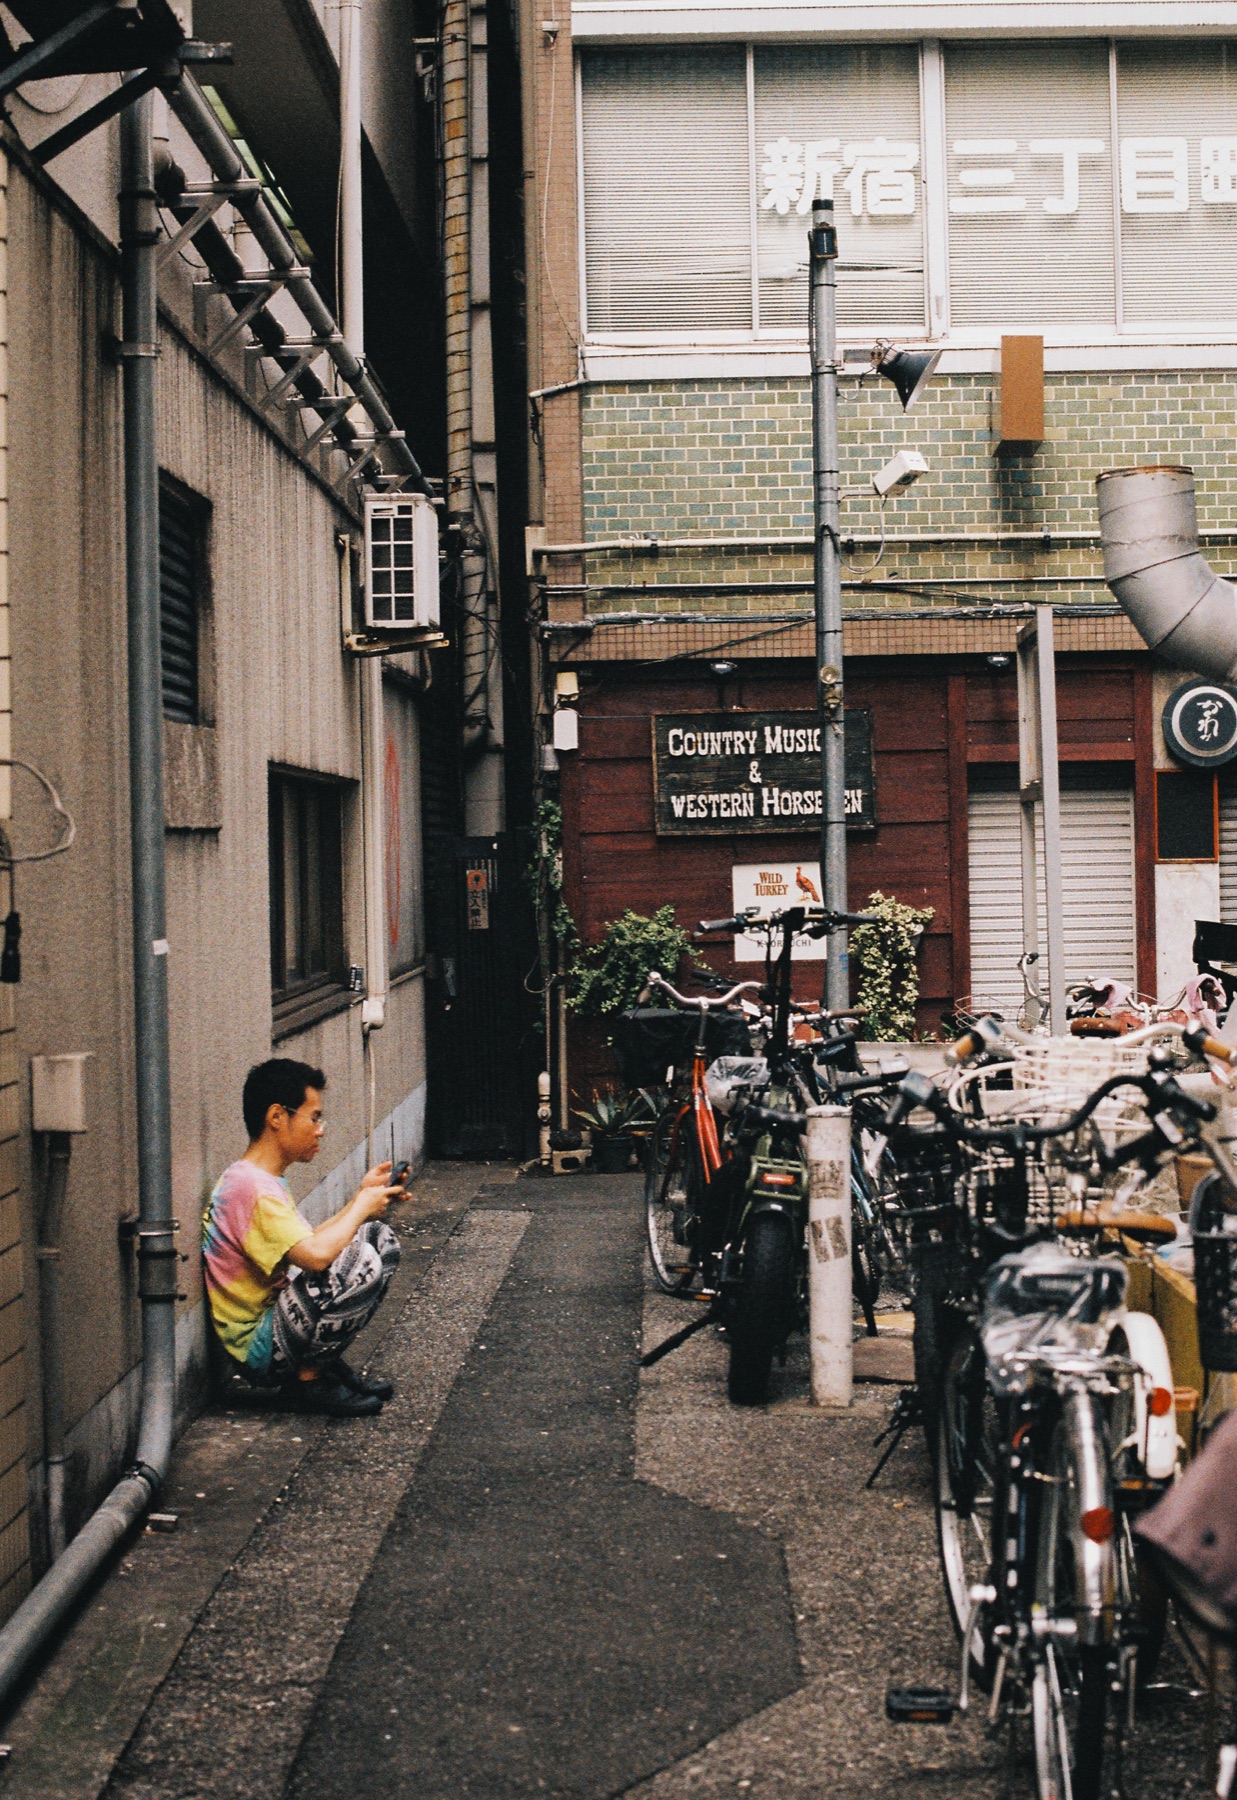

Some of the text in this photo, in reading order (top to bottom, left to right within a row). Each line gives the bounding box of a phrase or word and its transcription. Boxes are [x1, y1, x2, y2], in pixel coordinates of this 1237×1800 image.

[668, 728, 758, 756] COUNTRY
[748, 761, 762, 783] &
[671, 787, 863, 818] WESTERN HORSEEN
[759, 871, 782, 883] WILD
[753, 883, 789, 896] TURKEY
